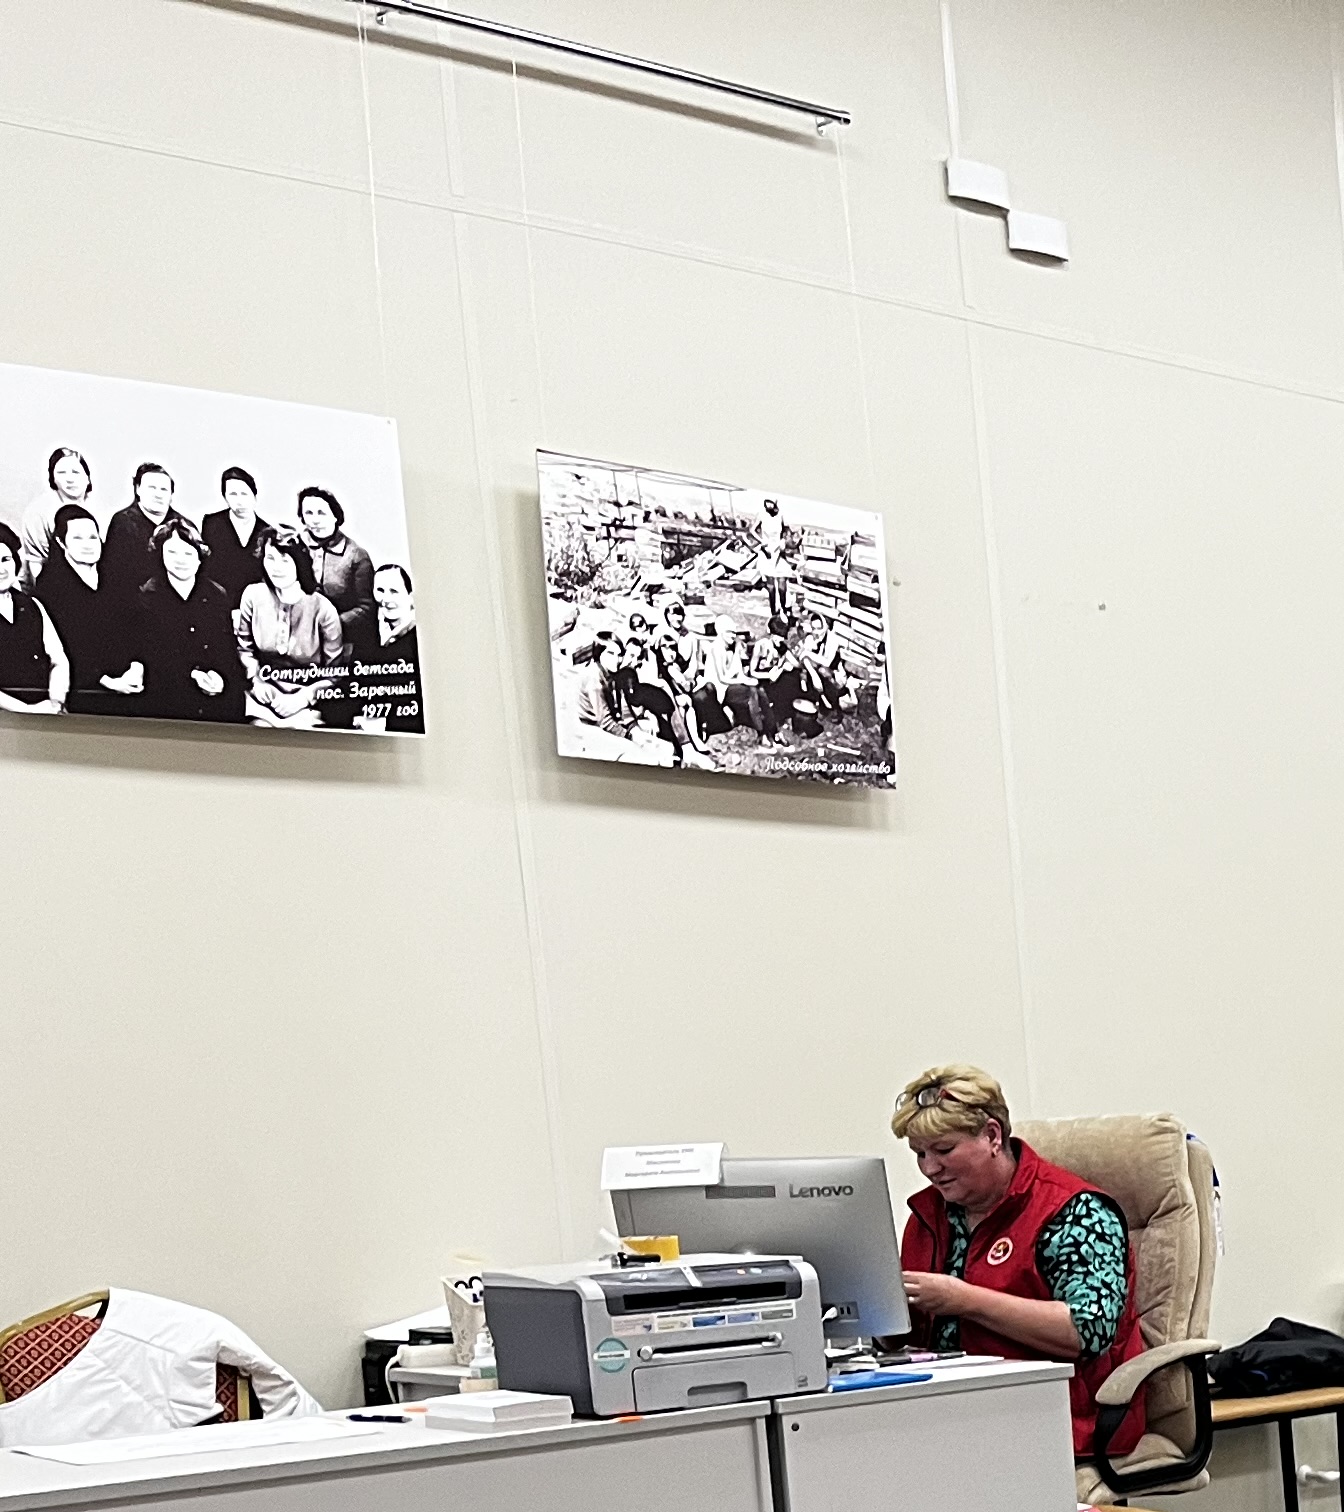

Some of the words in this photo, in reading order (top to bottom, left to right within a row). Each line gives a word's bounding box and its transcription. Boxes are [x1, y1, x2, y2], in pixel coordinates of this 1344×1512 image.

[259, 663, 349, 682] Сотрудники
[353, 659, 414, 676] детсада
[316, 687, 344, 700] пос.
[349, 681, 416, 700] Заречный
[362, 703, 392, 718] 1977
[396, 700, 418, 716] год
[789, 1183, 854, 1198] Lenovo
